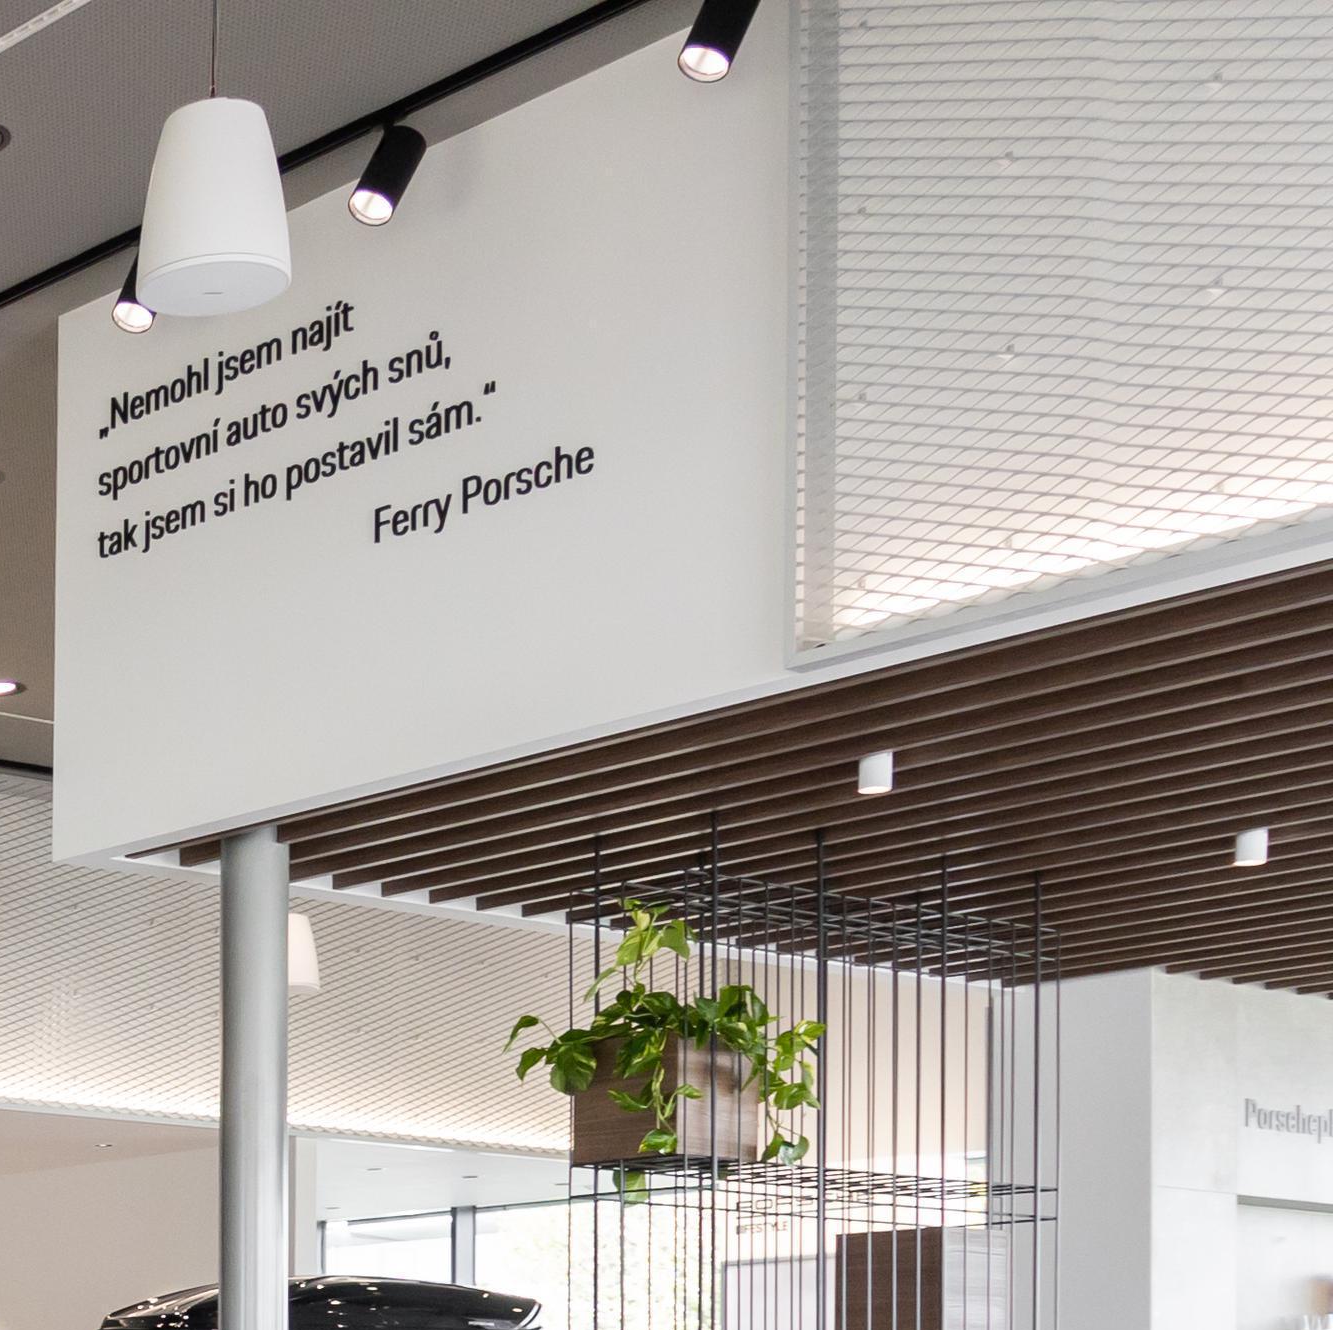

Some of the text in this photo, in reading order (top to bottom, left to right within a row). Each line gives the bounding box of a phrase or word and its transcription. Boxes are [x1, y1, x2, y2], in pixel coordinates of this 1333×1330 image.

[98, 300, 355, 440] „Nemohl jsem najít
[98, 330, 451, 501] sportovní auto svých snů,
[97, 518, 138, 559] tak
[141, 499, 206, 554] jsem
[213, 478, 235, 517] si
[242, 473, 278, 507] ho
[285, 416, 399, 501] postavil
[374, 445, 595, 544] Ferry Porsche
